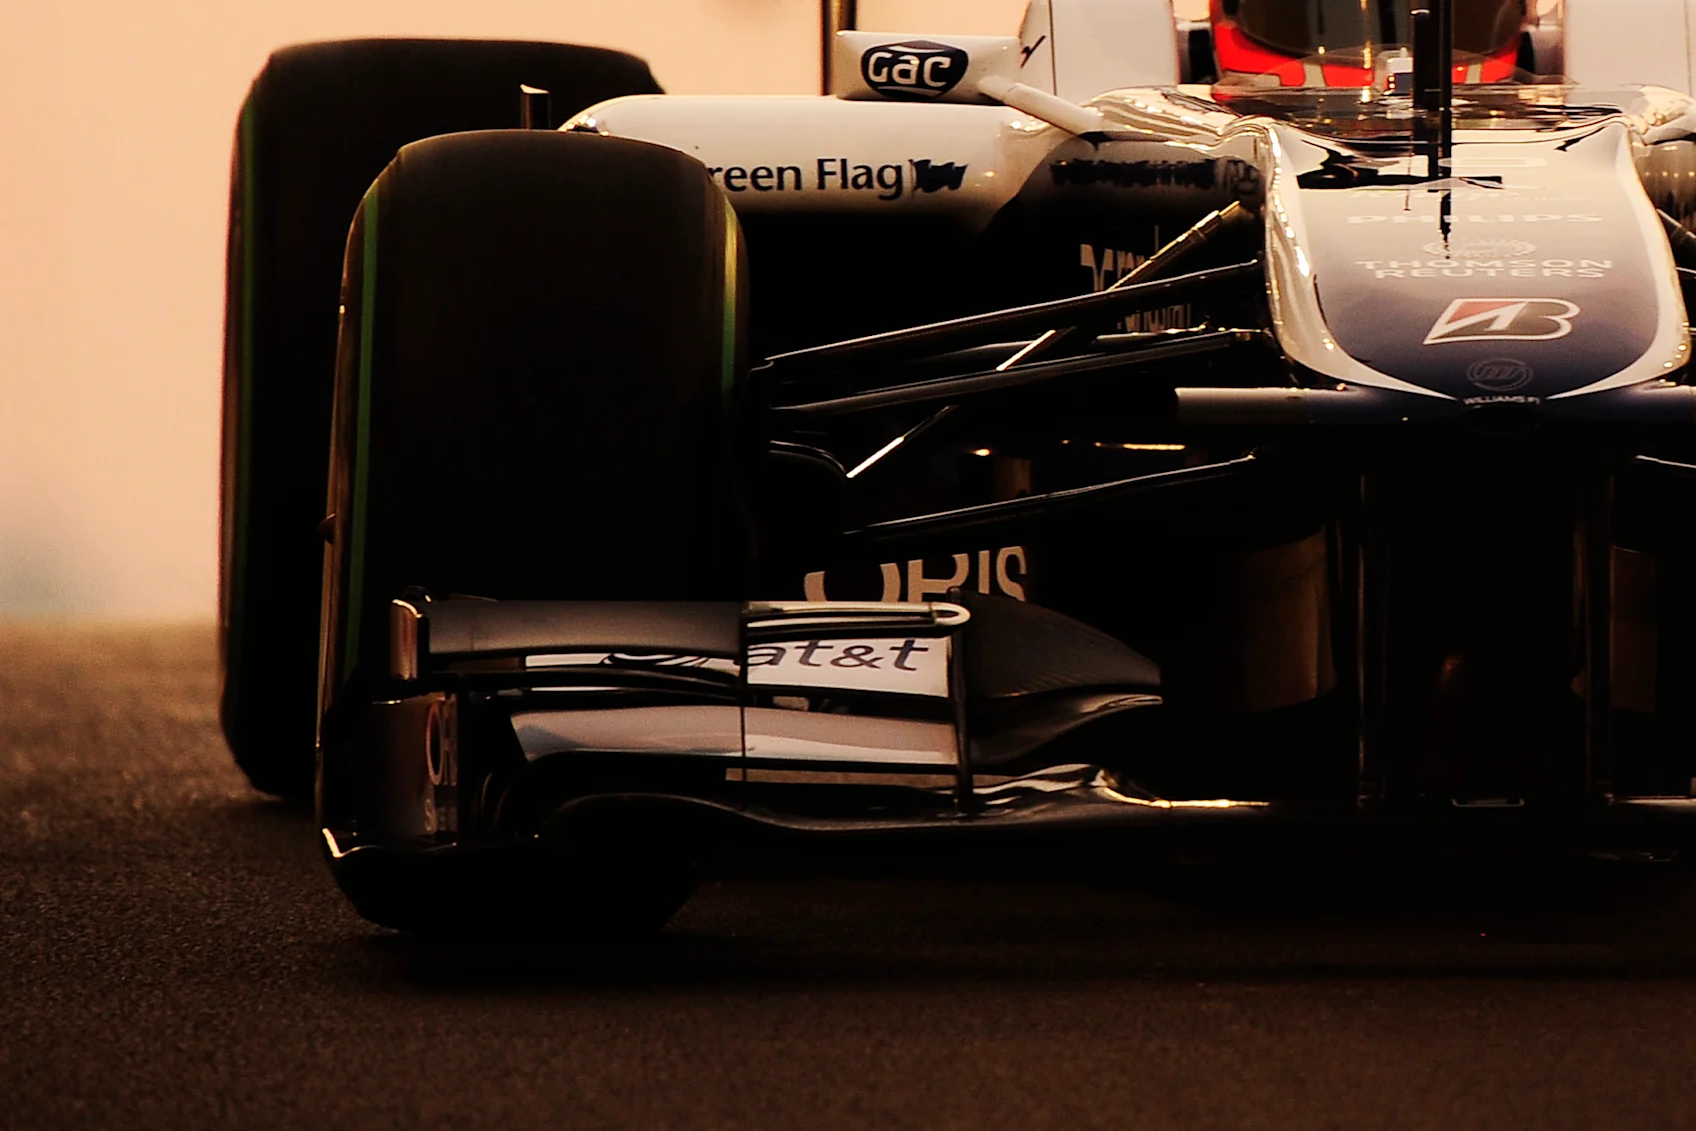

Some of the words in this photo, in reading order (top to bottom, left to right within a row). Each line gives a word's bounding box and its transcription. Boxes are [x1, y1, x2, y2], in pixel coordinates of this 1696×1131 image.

[707, 161, 802, 192] reen
[817, 158, 904, 201] Flag
[1354, 258, 1614, 271] THOMSON
[1374, 268, 1607, 280] REUTERS
